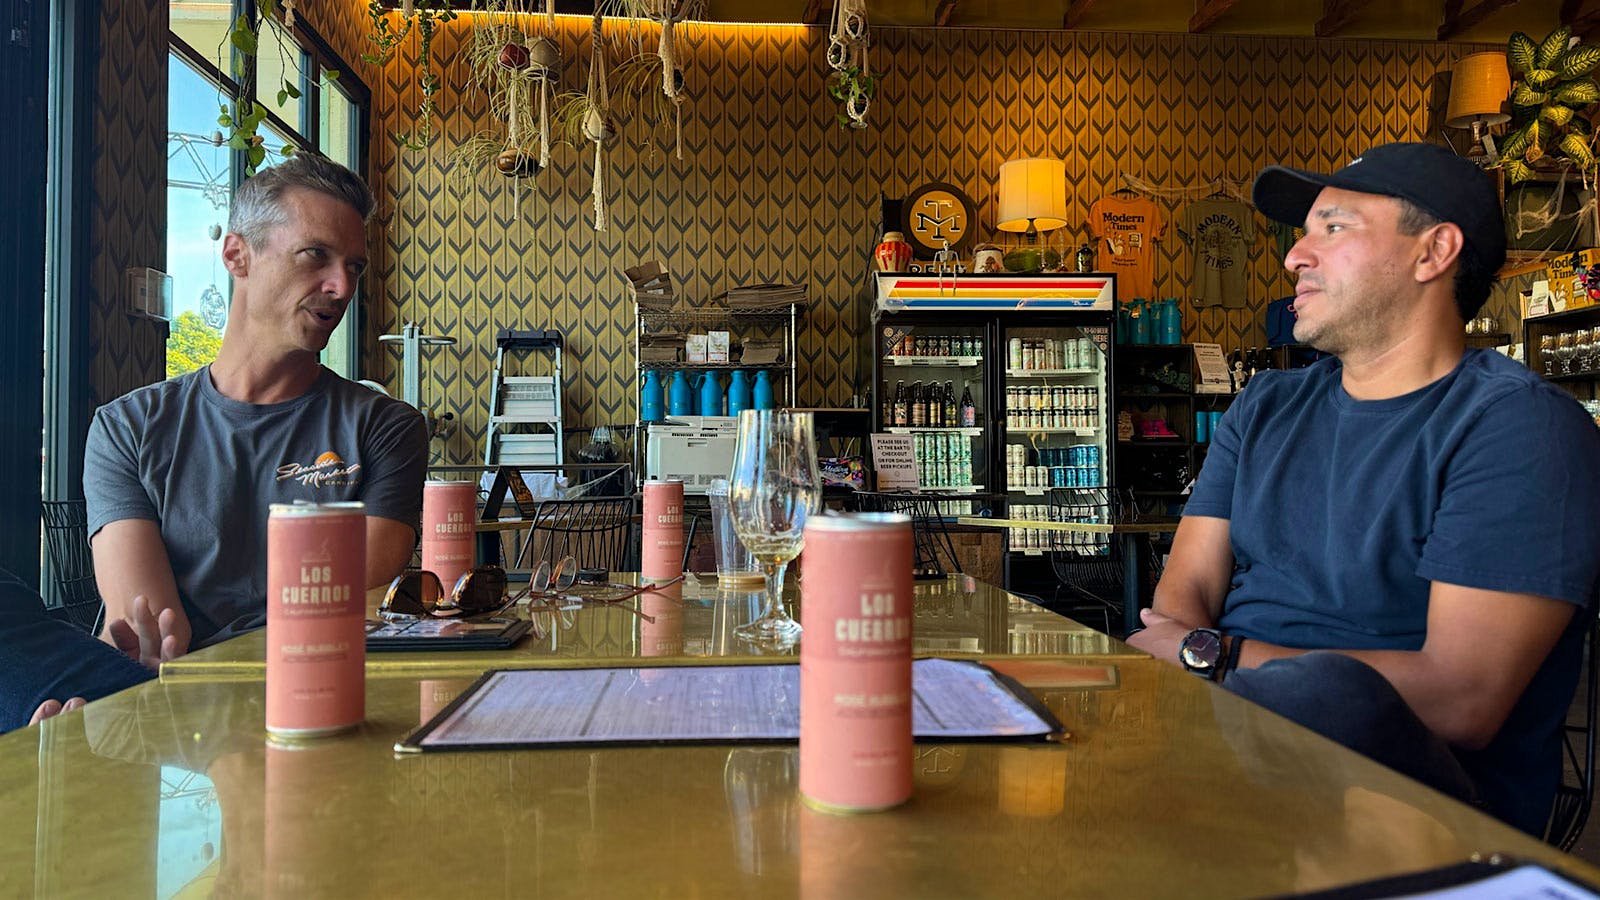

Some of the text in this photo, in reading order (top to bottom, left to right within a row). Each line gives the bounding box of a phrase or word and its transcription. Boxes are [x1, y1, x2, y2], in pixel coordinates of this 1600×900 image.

[1103, 212, 1145, 223] Modern
[1111, 222, 1137, 231] Times
[1197, 214, 1241, 234] MODERN
[295, 464, 361, 488] Market
[447, 512, 463, 522] LOS
[301, 566, 331, 584] LOS
[282, 585, 350, 604] CUERNOS
